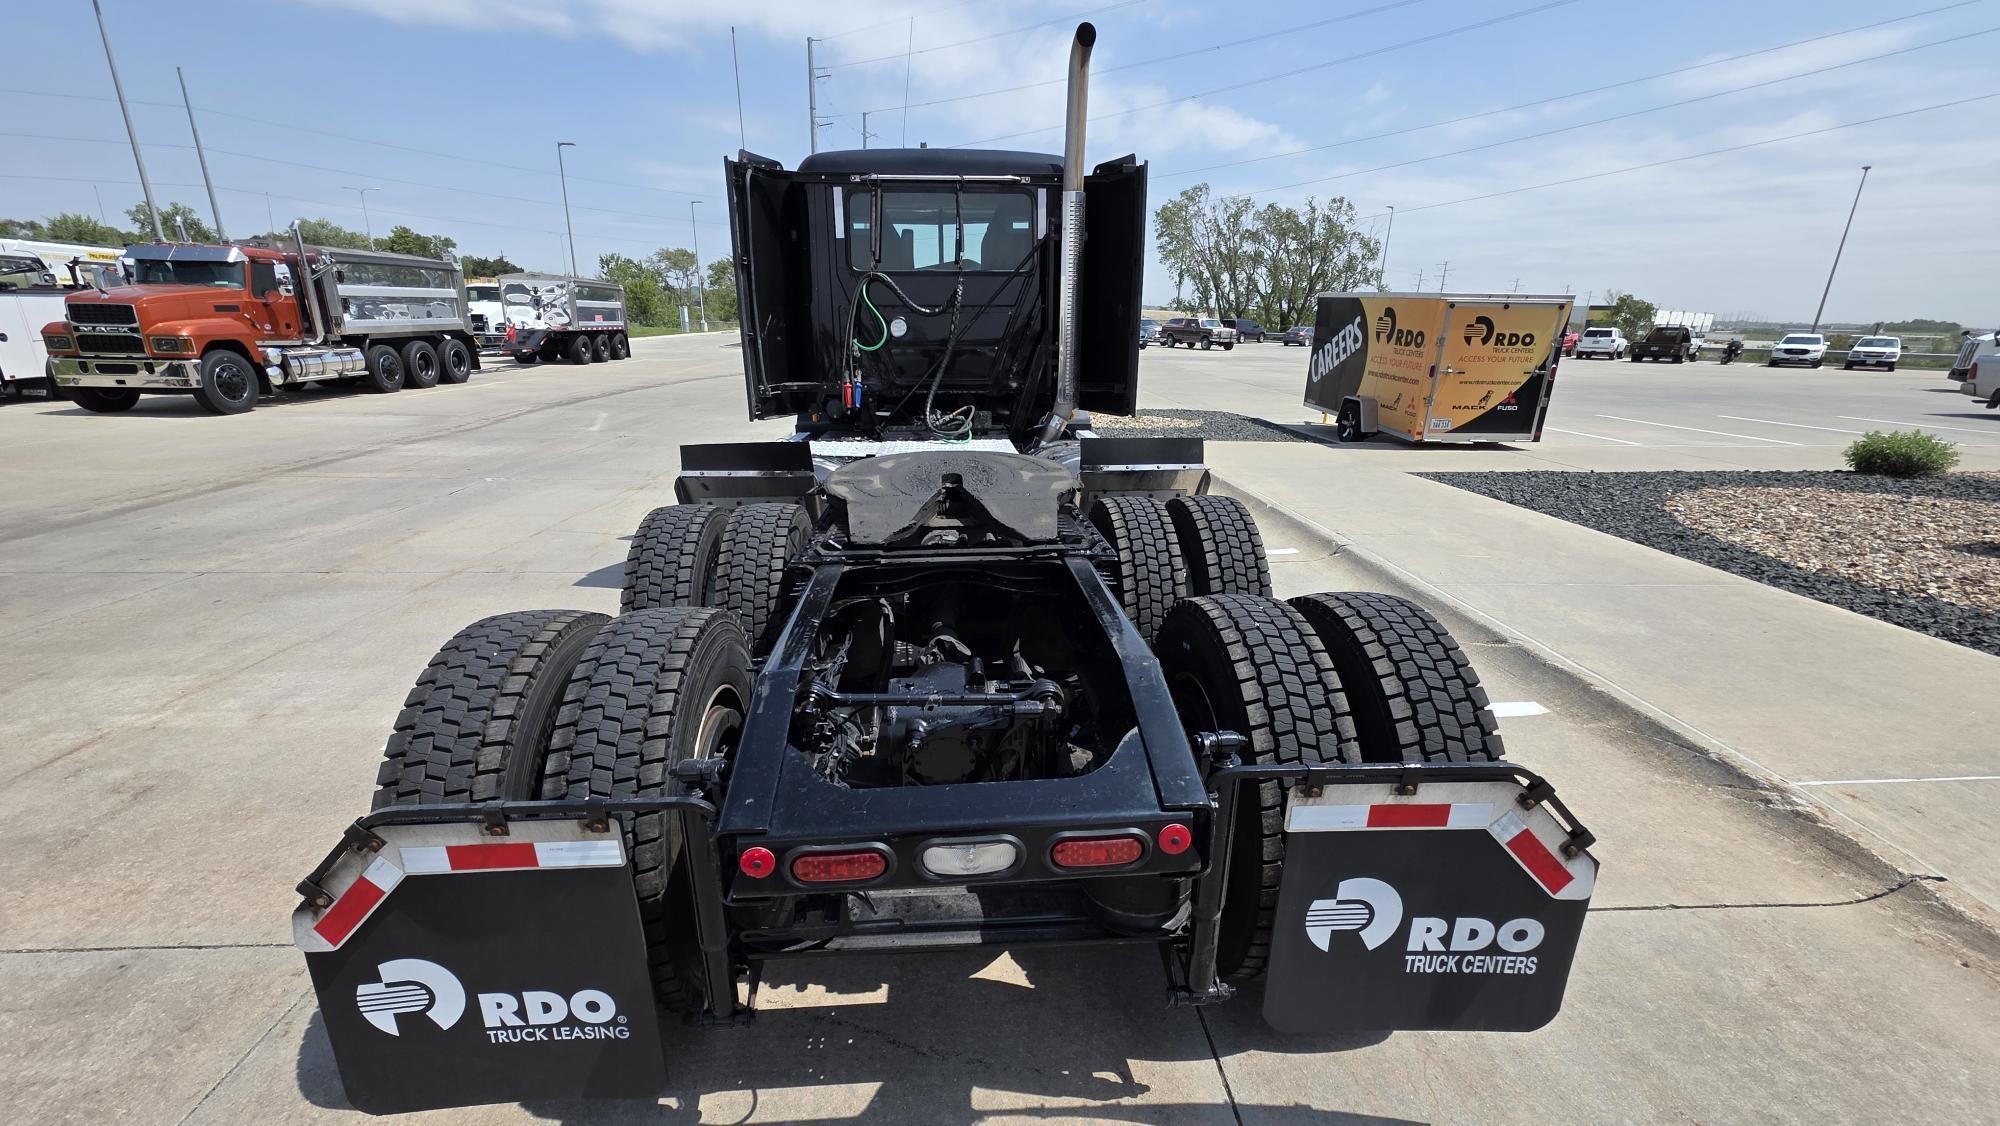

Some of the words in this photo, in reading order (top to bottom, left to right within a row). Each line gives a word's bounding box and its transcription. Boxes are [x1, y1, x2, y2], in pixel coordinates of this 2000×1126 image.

[1394, 328, 1425, 349] RDO
[1493, 332, 1535, 347] RDO
[1311, 315, 1363, 383] CAREERS
[1458, 355, 1486, 363] ACCESS
[1406, 917, 1545, 953] RDO
[1405, 955, 1460, 973] TRUCK
[1462, 955, 1538, 975] CENTERS
[486, 1027, 549, 1043] TRUCK
[552, 1026, 630, 1041] LEASING
